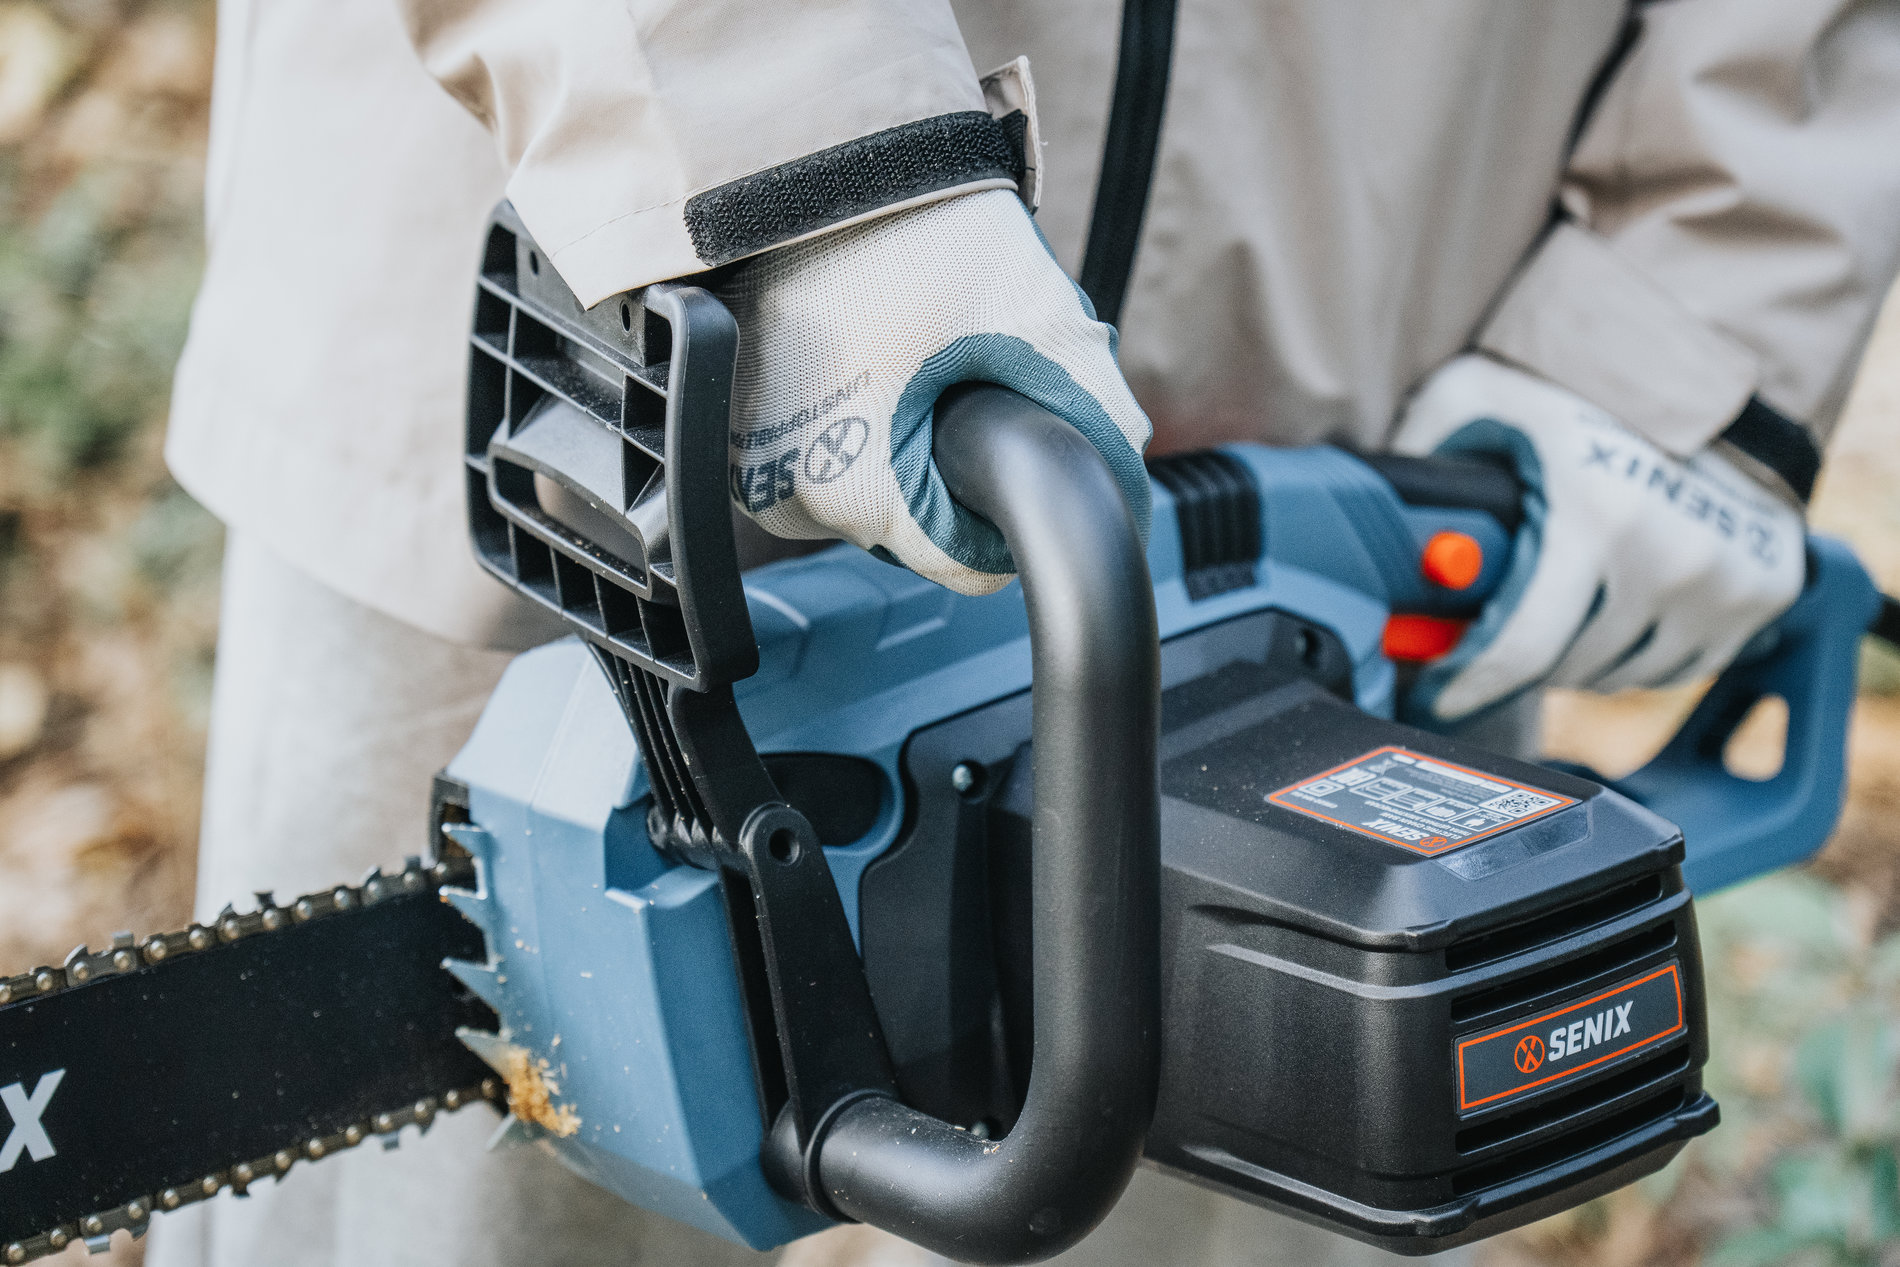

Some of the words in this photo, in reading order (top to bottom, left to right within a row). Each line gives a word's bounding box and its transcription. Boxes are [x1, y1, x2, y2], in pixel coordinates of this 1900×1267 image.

[1582, 440, 1738, 541] SENIX
[1361, 818, 1431, 841] SENIX
[1548, 1000, 1634, 1063] SENIX
